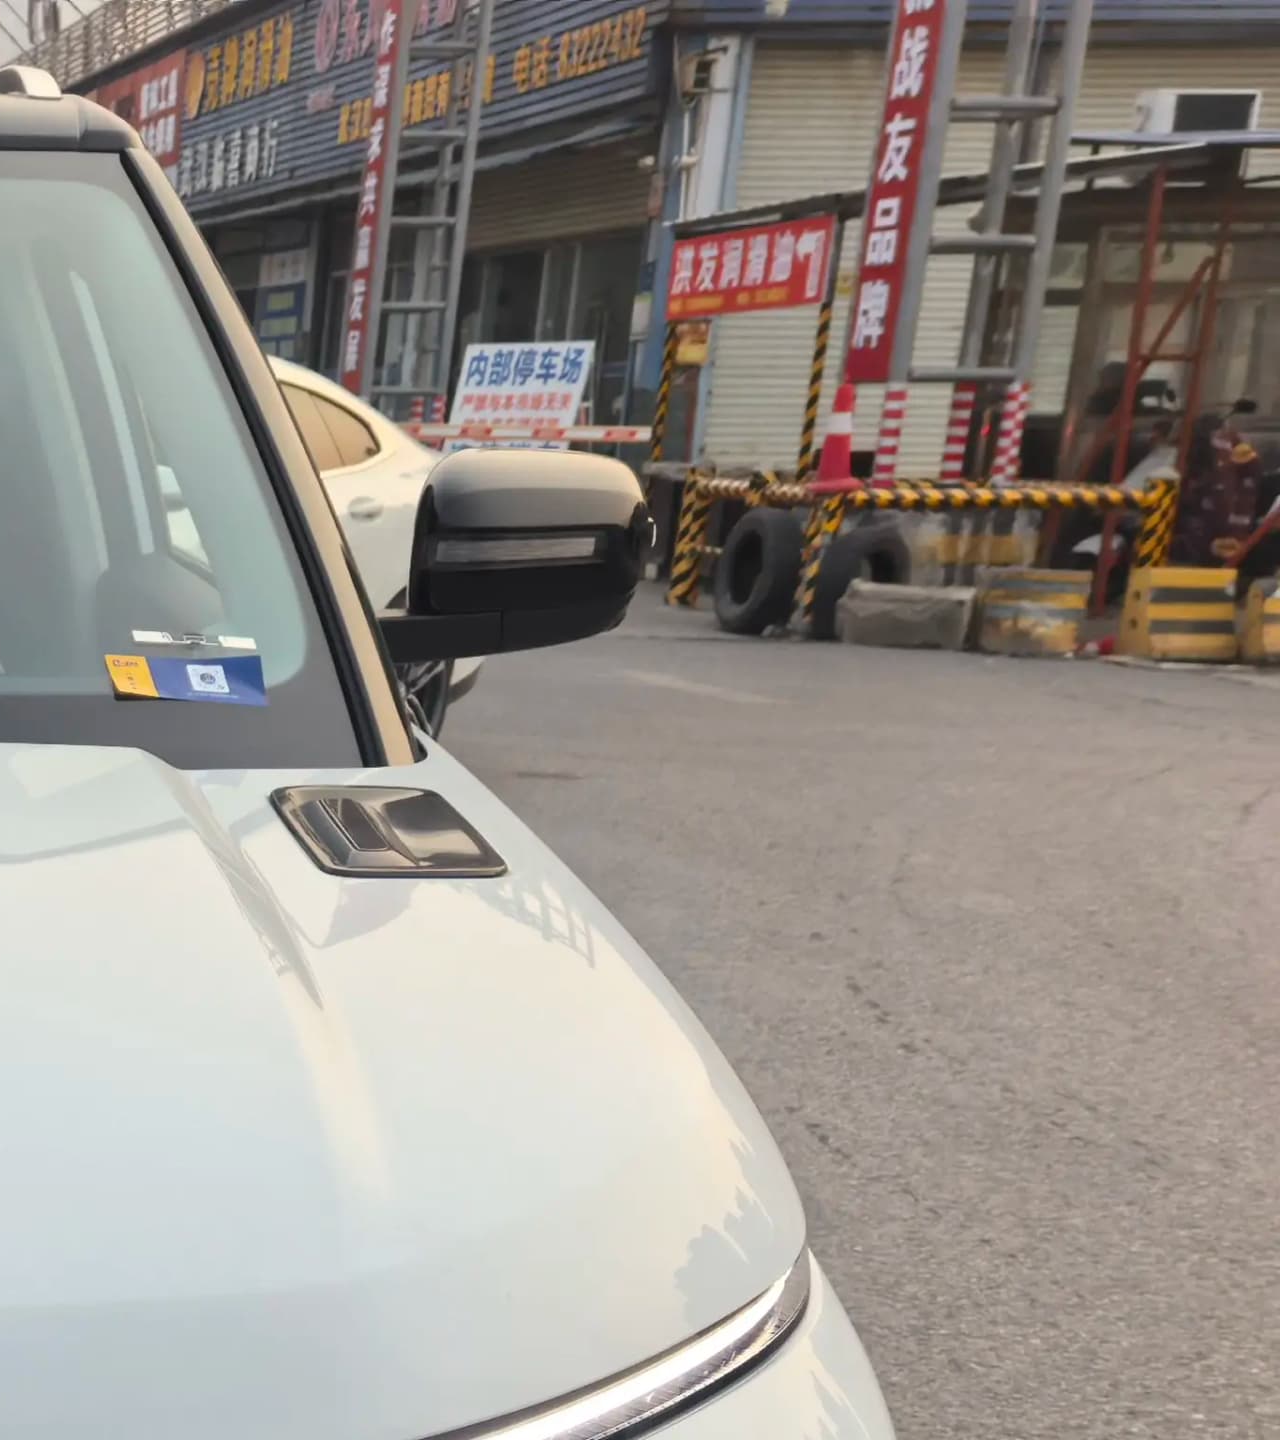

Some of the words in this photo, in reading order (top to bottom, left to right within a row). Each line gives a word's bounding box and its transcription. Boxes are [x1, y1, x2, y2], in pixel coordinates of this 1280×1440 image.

[852, 0, 935, 348] 战友品牌
[465, 347, 585, 387] 内部停车场
